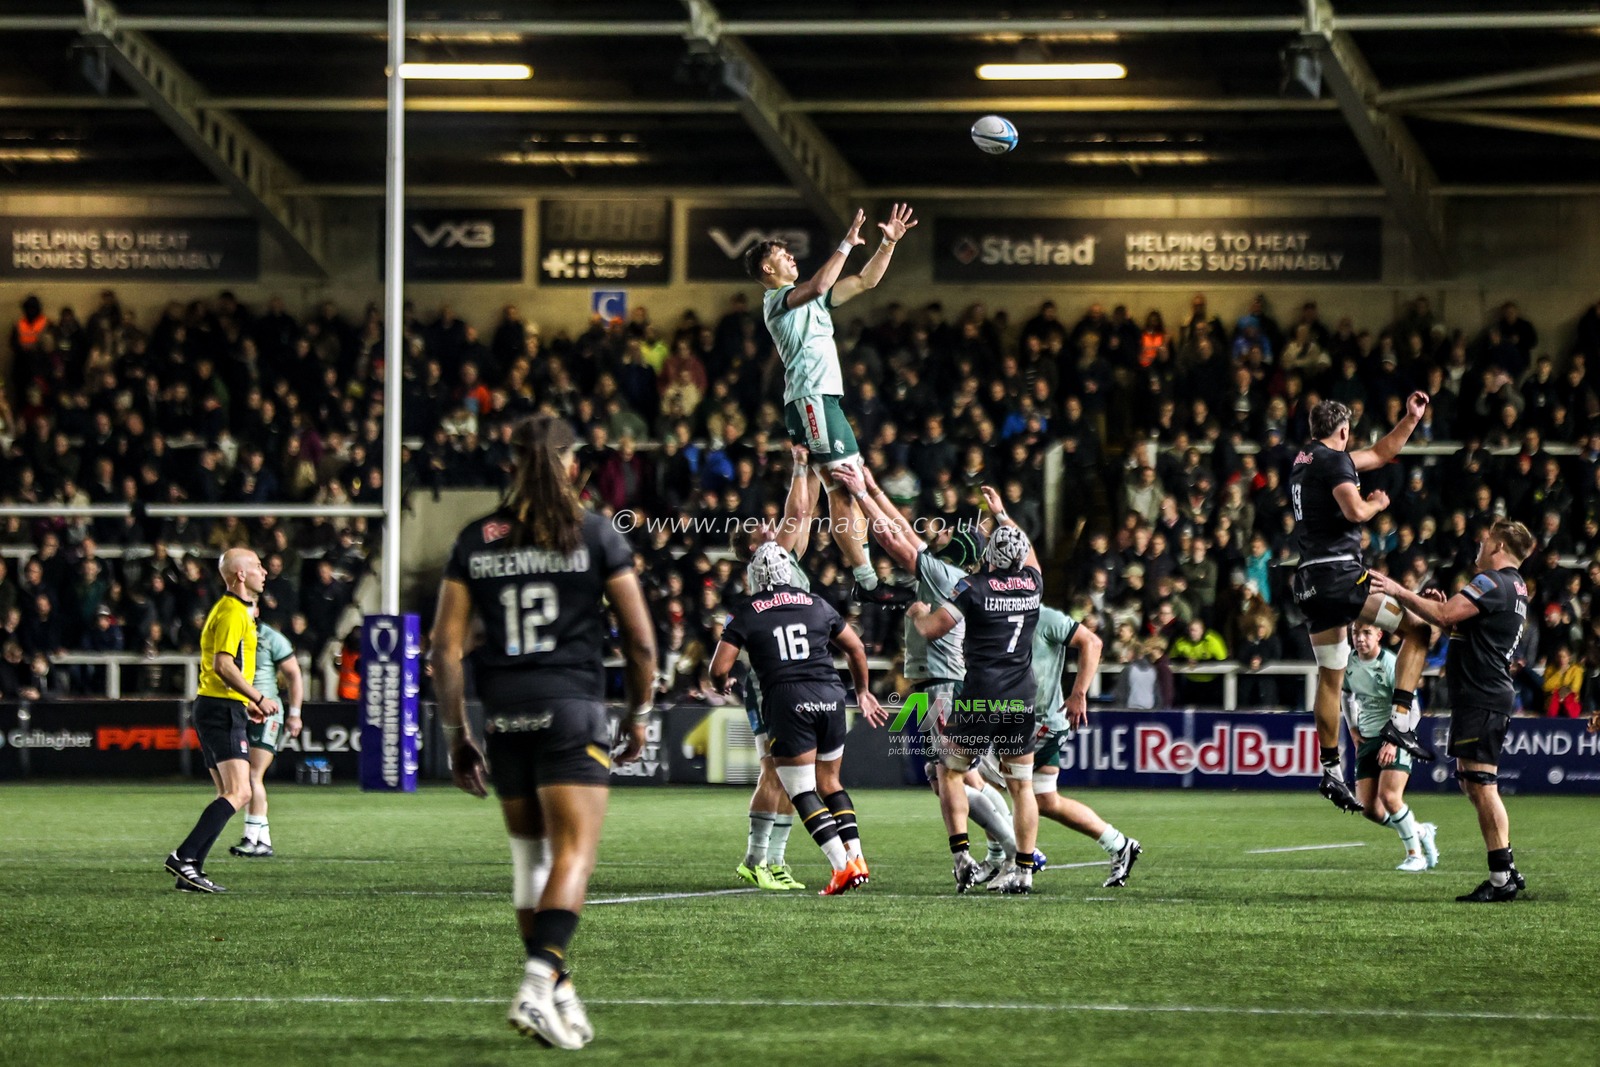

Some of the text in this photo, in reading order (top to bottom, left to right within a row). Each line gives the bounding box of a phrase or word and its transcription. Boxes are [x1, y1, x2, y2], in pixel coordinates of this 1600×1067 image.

[12, 231, 189, 250] HELPING TO HEAT
[412, 222, 495, 248] VX3
[1125, 232, 1309, 252] HELPING TO HEAT
[12, 251, 223, 269] HOMES SUSTAINABLY
[980, 235, 1096, 266] Stelrad
[1125, 253, 1343, 272] HOMES SUSTAINABLY
[598, 295, 621, 322] C
[808, 411, 820, 439] SPAR
[482, 521, 511, 544] Re
[468, 546, 591, 579] GREENWOOD
[987, 577, 1014, 591] Red
[752, 592, 814, 613] Red Bulls
[500, 582, 560, 656] 12
[772, 622, 811, 661] 16
[1006, 613, 1025, 653] 7
[366, 663, 383, 729] RUGBY
[803, 701, 837, 712] Stelrad
[383, 663, 399, 788] PREMIERSHIP
[8, 730, 93, 751] Gallagher
[1232, 725, 1323, 777] Bull
[1576, 732, 1600, 756] H
